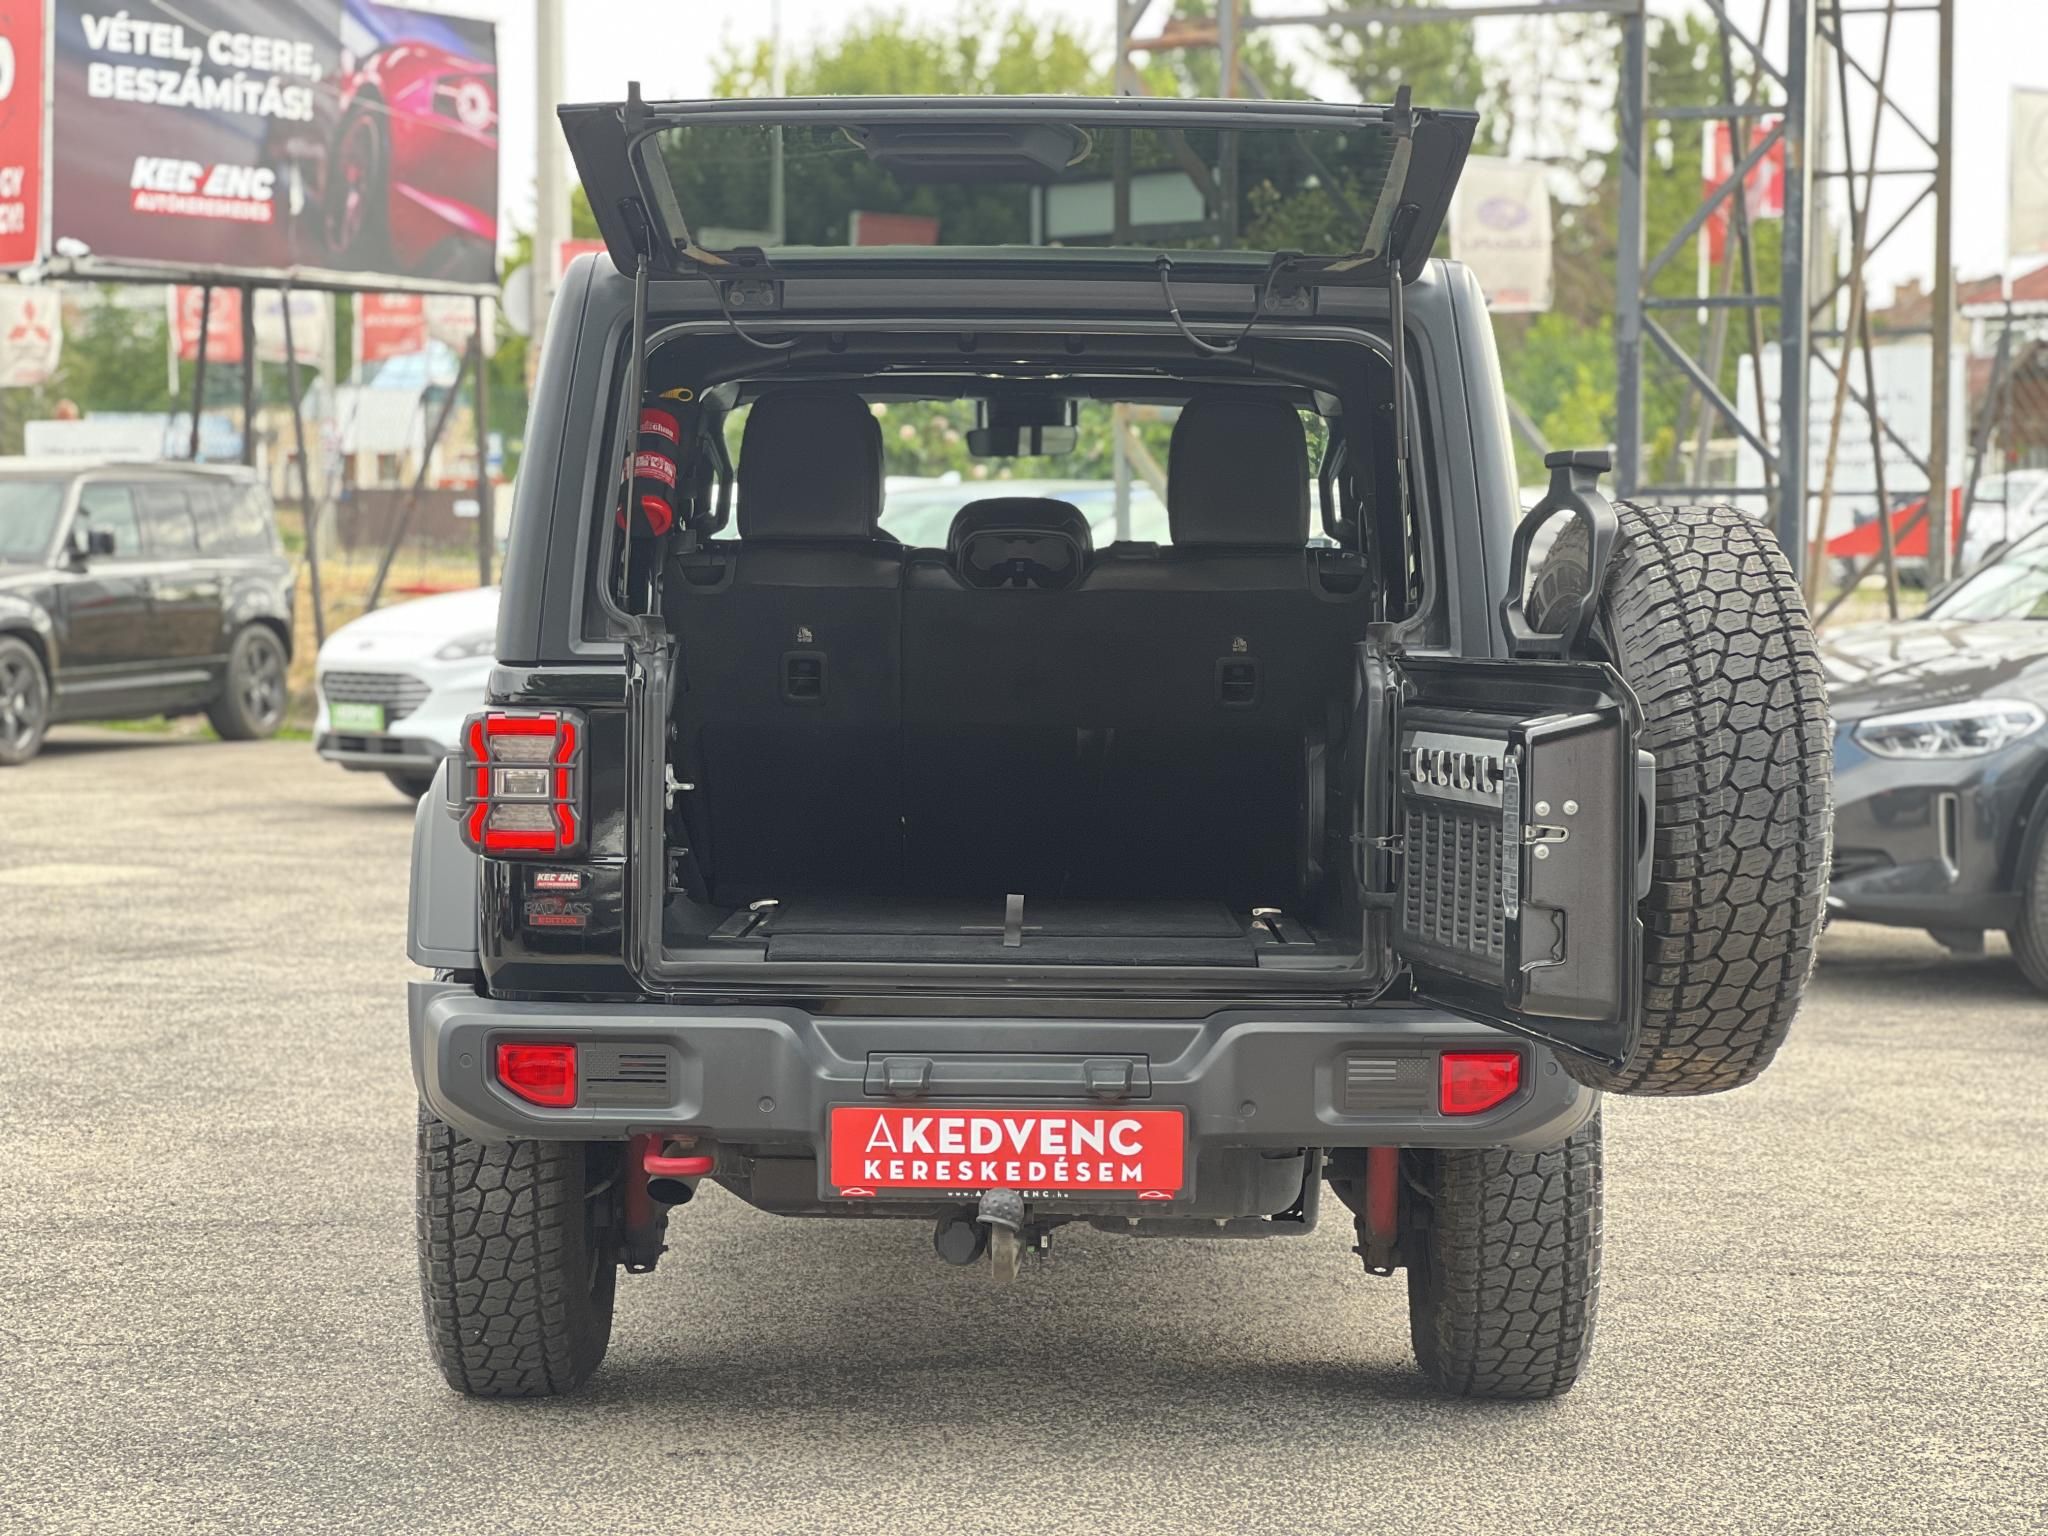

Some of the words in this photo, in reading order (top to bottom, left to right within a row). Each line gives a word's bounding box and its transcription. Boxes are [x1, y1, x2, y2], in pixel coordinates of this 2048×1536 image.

[80, 10, 203, 66] VÉTEL,
[207, 30, 322, 82] CSERE,
[88, 62, 314, 122] BESZÁMÍTÁS!
[865, 1157, 1143, 1182] KERESKEDÉSEM
